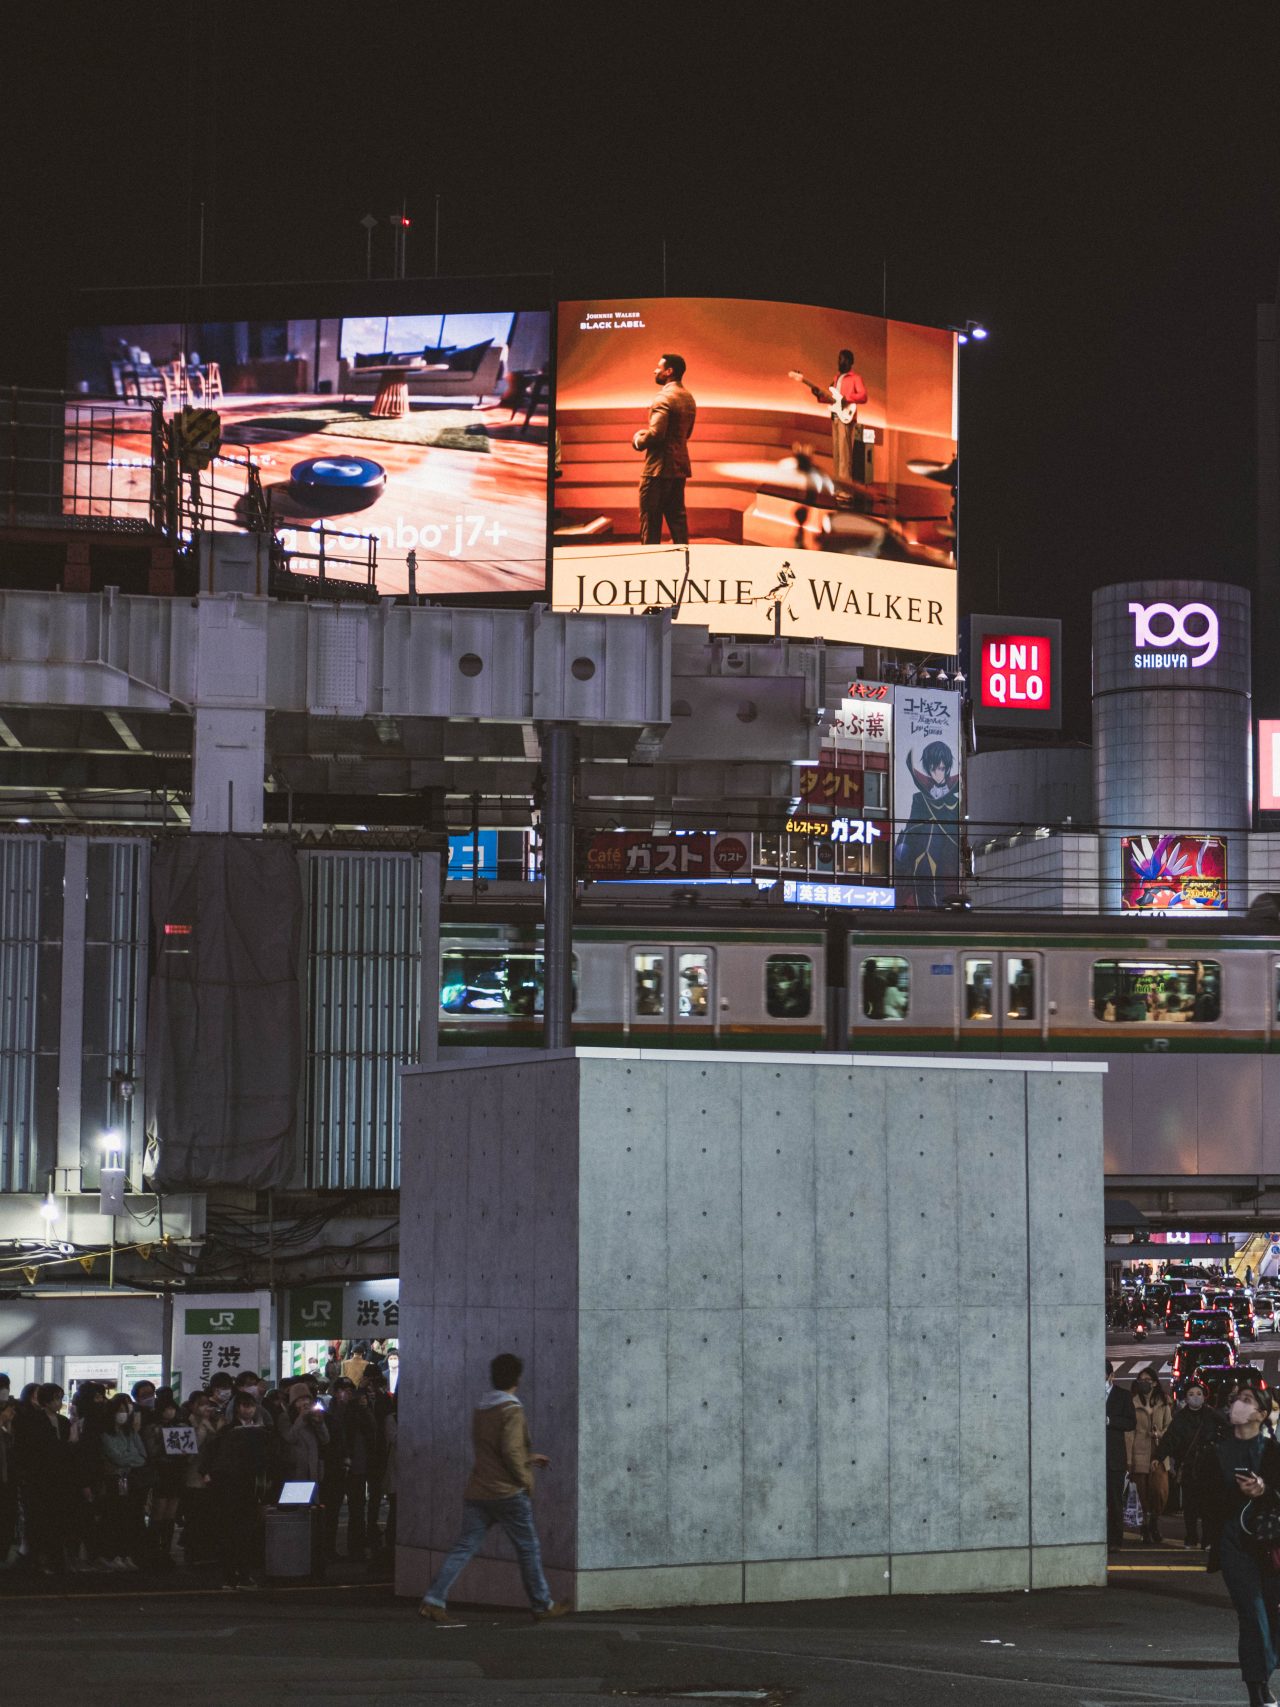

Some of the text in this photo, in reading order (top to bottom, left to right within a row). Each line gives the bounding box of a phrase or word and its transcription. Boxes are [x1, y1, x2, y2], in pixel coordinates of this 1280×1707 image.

[580, 320, 646, 330] BLACK LABEL
[311, 514, 508, 557] Combo j7+
[1128, 602, 1219, 668] 109
[989, 643, 1038, 670] UNI
[1134, 654, 1188, 669] SHIBUYA
[989, 674, 1043, 704] QLO
[904, 697, 951, 718] コードギアス
[831, 817, 881, 844] ガスト
[587, 846, 621, 864] Café
[626, 843, 703, 874] ガスト
[718, 851, 743, 862] ガスト
[799, 884, 893, 906] 英会話イーオン
[209, 1312, 235, 1326] JR
[302, 1300, 332, 1320] JR
